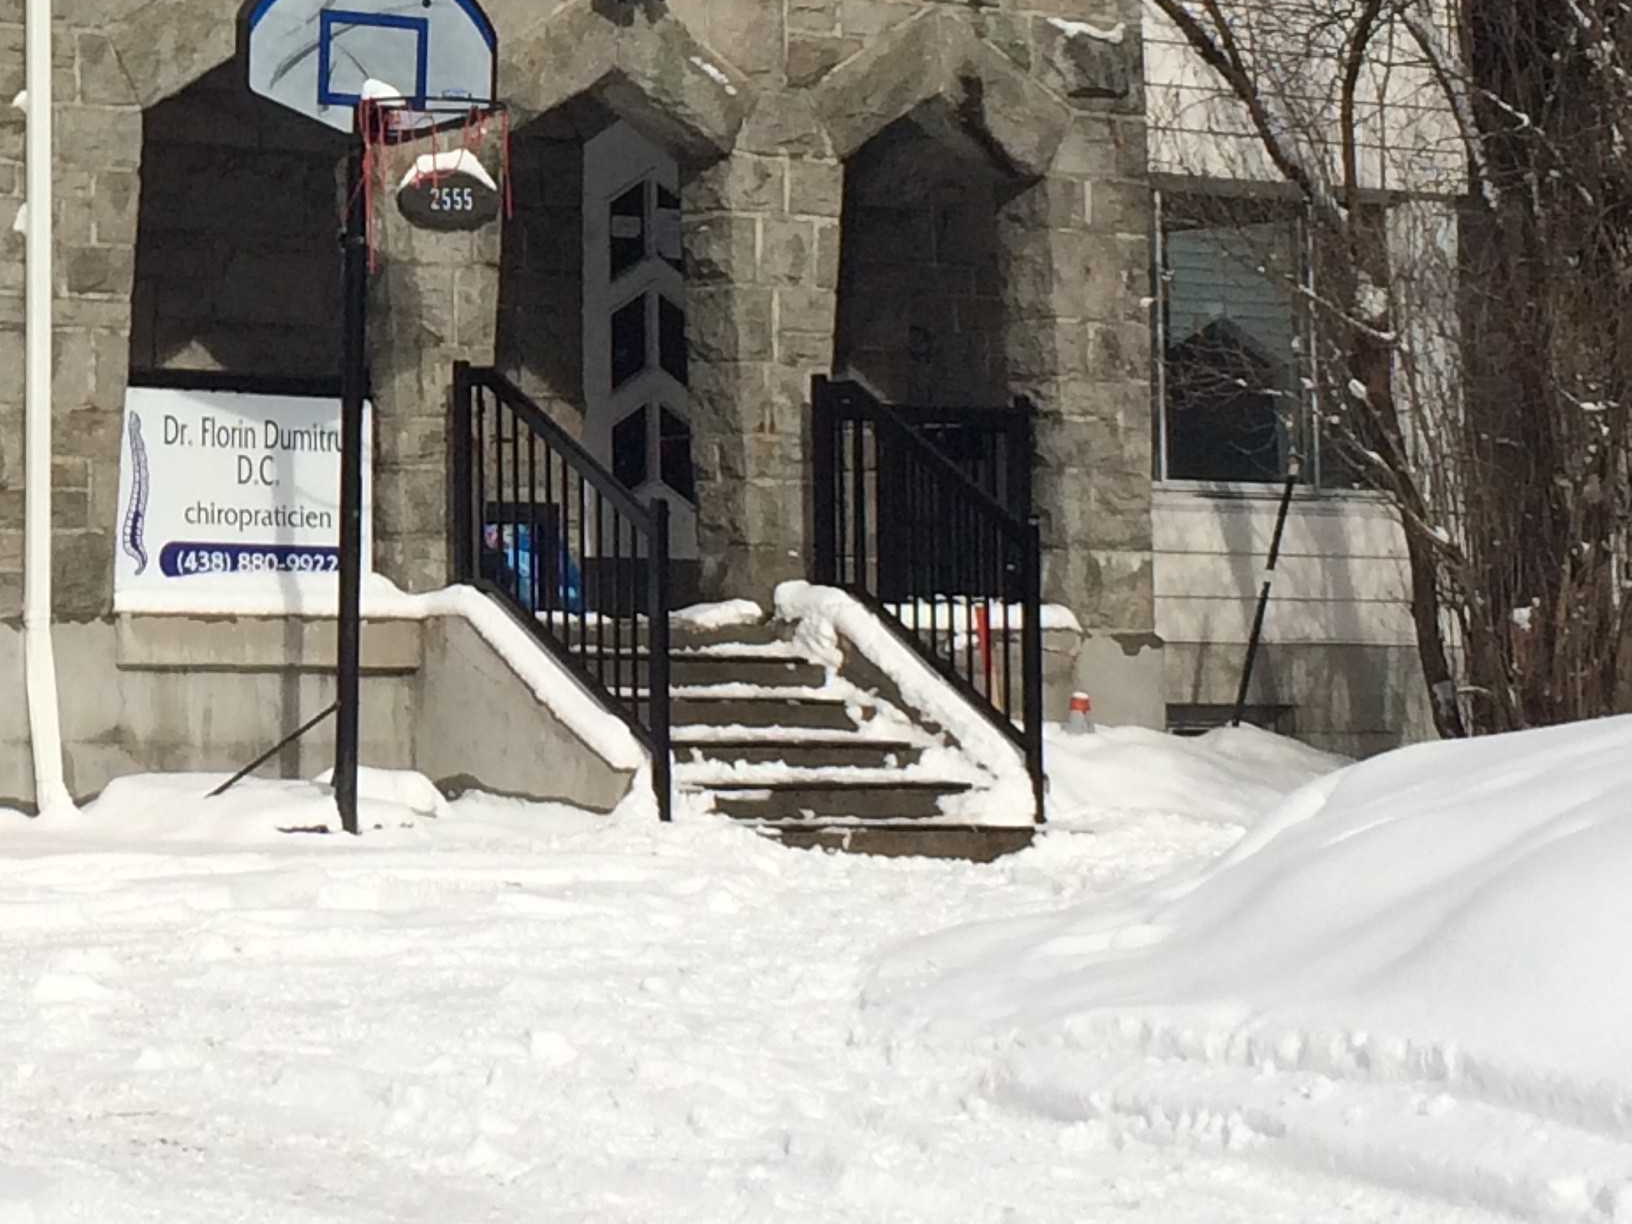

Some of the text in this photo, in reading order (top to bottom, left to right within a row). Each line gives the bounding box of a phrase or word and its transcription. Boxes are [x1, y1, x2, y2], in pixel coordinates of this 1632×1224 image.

[430, 186, 473, 211] 2555
[163, 414, 194, 447] Dr.
[201, 416, 257, 450] Florin
[236, 454, 280, 487] D.C.
[184, 500, 332, 533] chiropraticien
[176, 549, 232, 575] (438)
